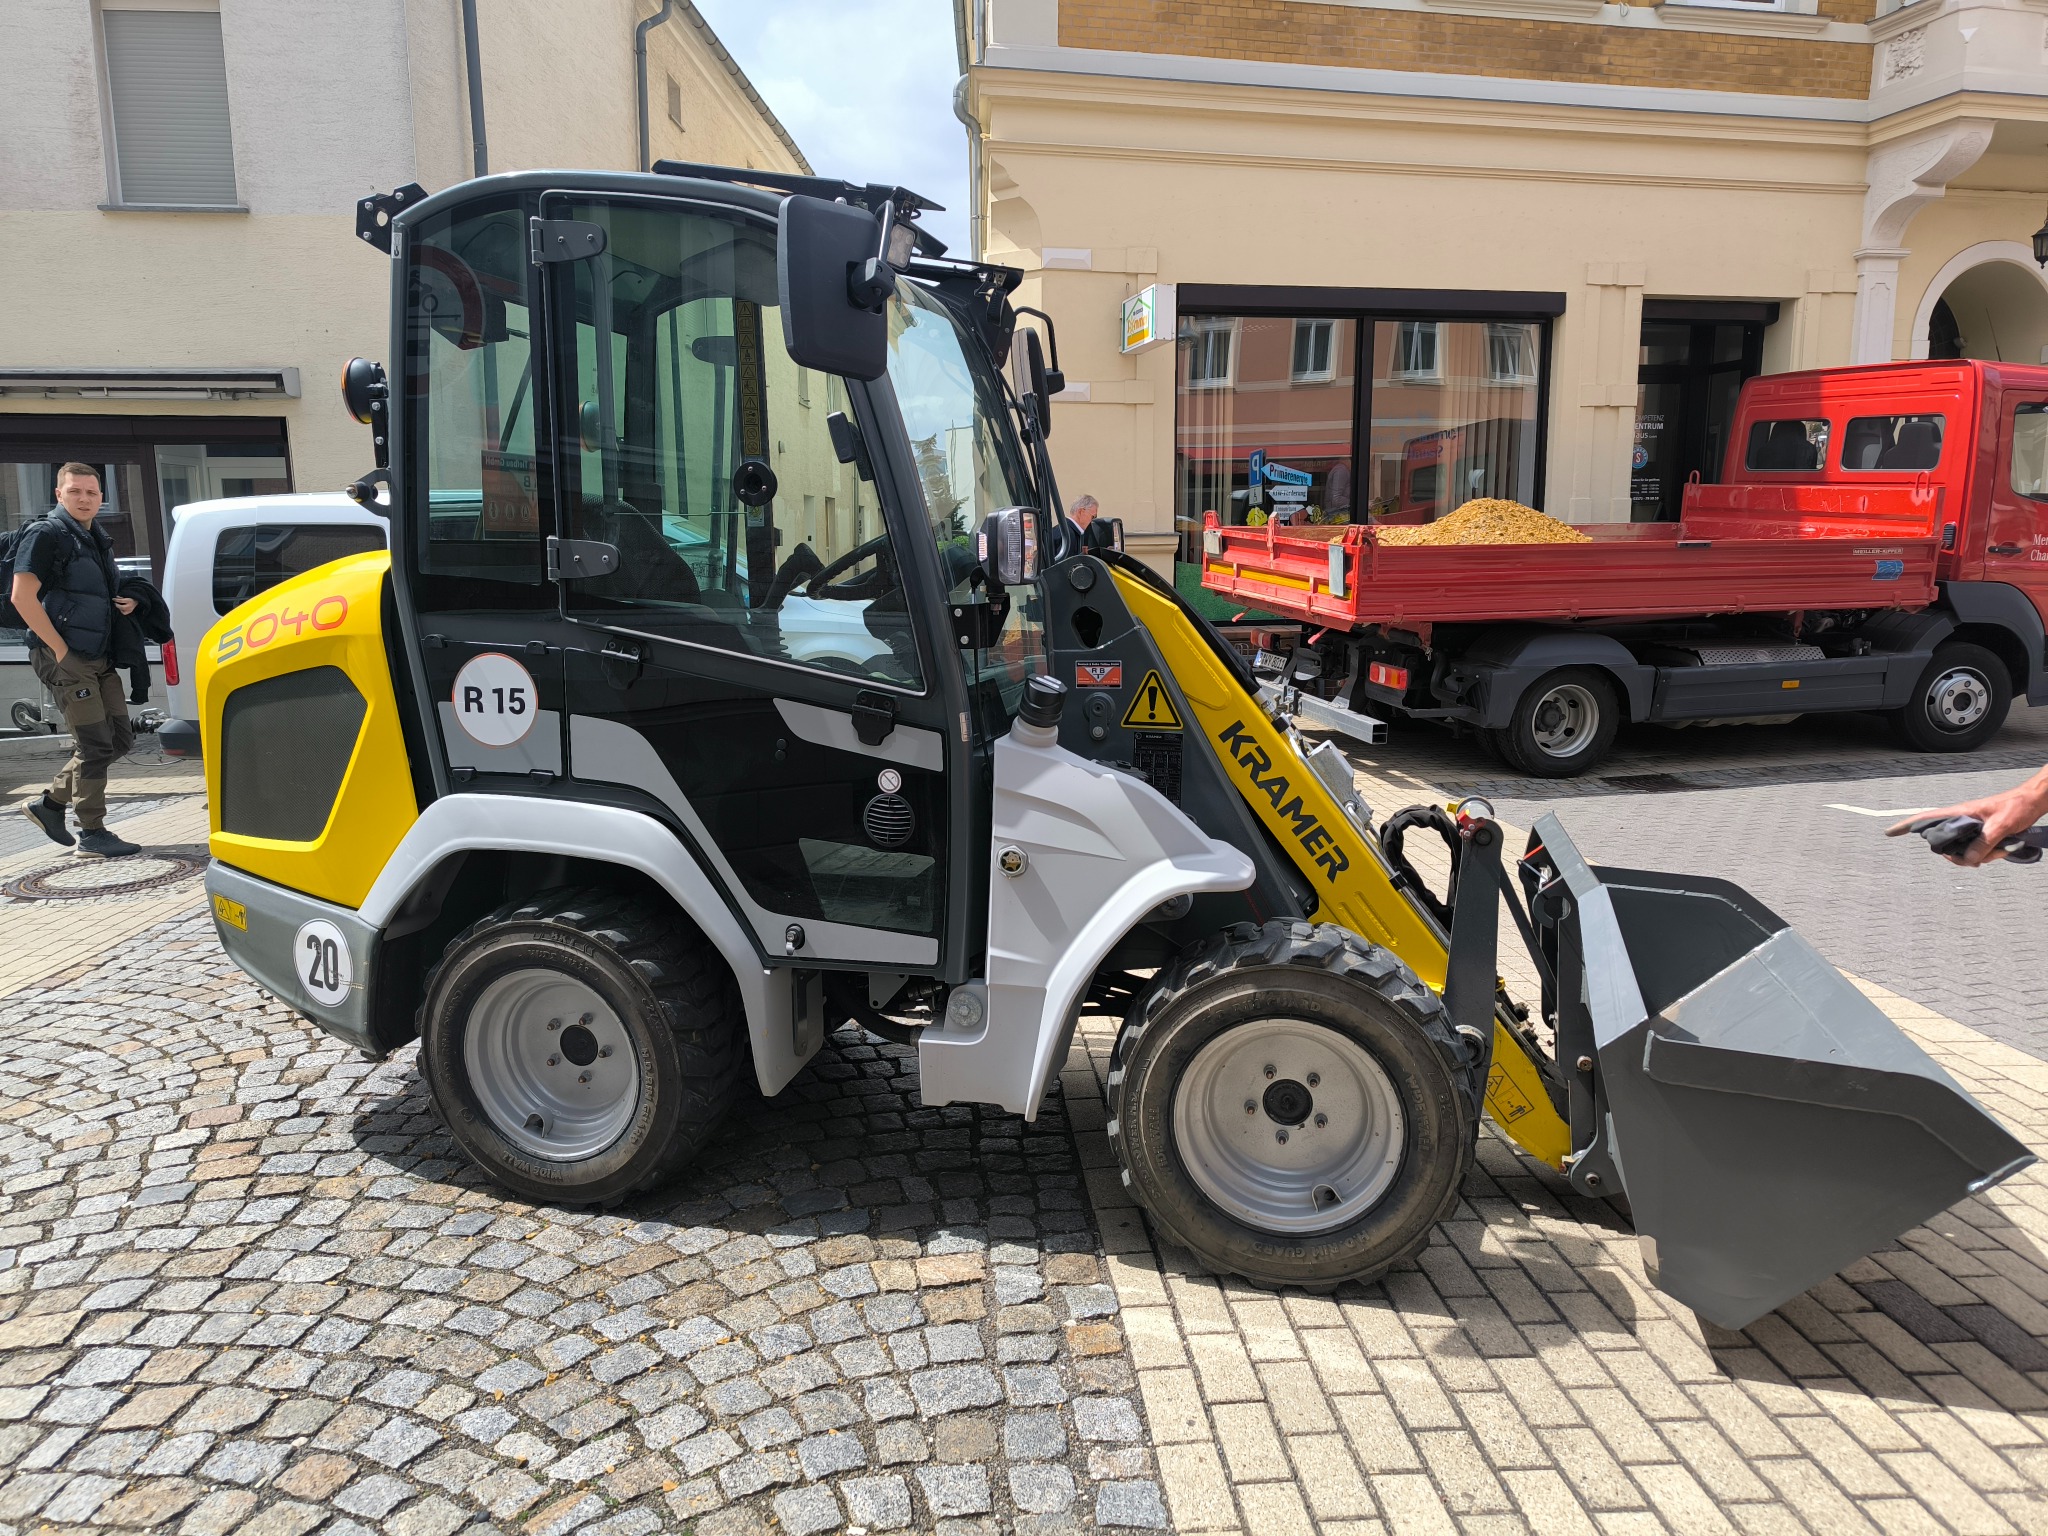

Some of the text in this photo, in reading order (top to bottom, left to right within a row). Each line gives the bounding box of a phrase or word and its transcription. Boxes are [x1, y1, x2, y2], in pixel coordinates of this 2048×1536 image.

[1634, 422, 1664, 430] ENTRUM
[1635, 414, 1665, 422] OMPETENZ
[216, 595, 348, 665] 5040
[464, 687, 527, 716] R 15
[1218, 719, 1350, 883] KRAMER
[306, 934, 340, 993] 20
[1252, 1241, 1306, 1258] GUARD
